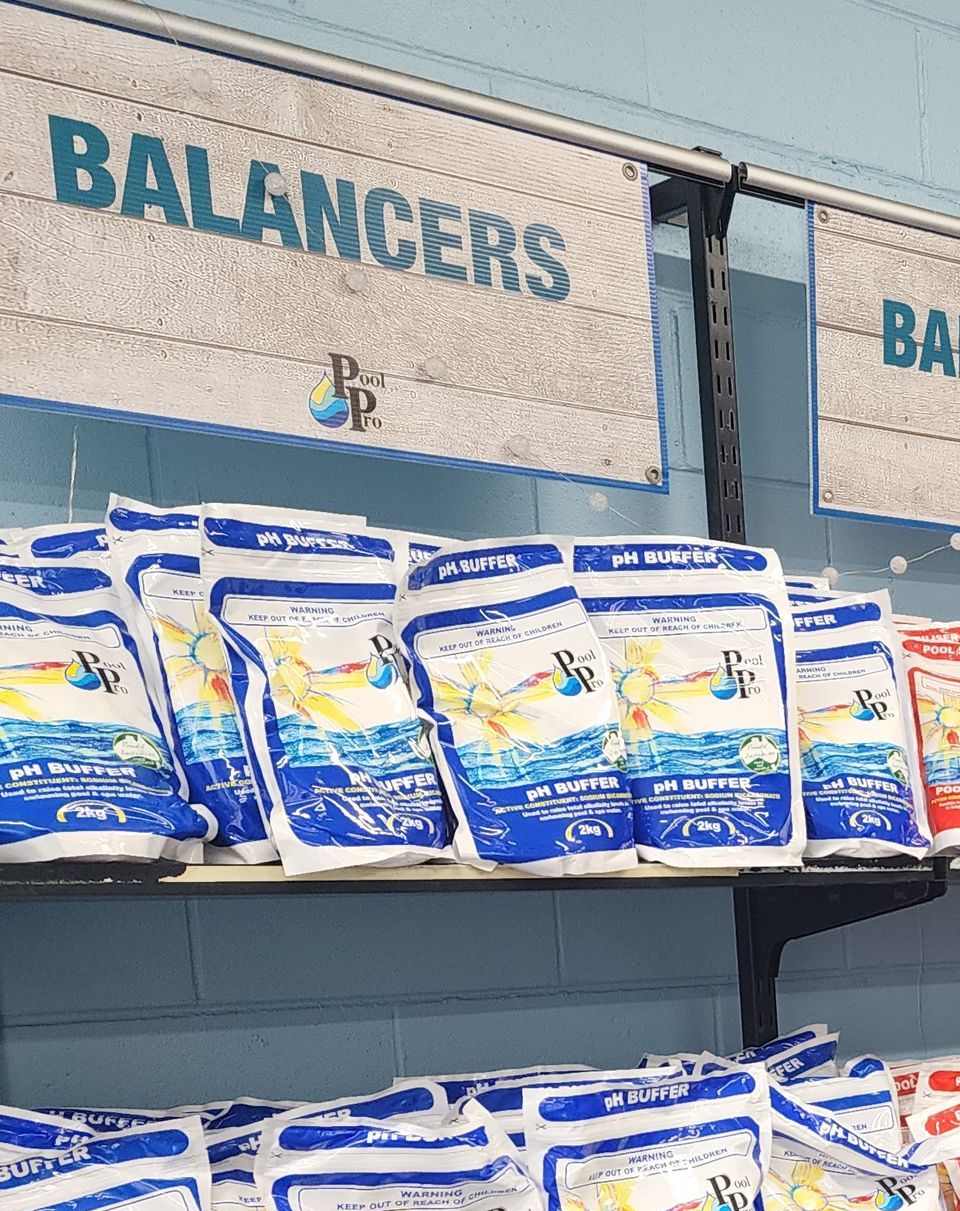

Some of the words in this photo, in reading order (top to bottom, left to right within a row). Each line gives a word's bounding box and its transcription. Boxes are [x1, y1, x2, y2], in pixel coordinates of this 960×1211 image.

[48, 114, 570, 302] BALANCERS
[328, 353, 386, 399] Pool
[348, 386, 383, 432] Pro
[438, 564, 459, 580] pH
[459, 554, 519, 575] BUFFER
[612, 553, 639, 567] pH
[643, 550, 718, 566] BUFFER
[290, 605, 334, 615] WARNING
[651, 616, 696, 624] WARNING
[475, 624, 516, 638] WARNING
[923, 645, 957, 656] POOL
[553, 649, 597, 678] Pool
[721, 650, 764, 679] Pool
[854, 688, 891, 710] Pool
[9, 766, 34, 781] pH
[50, 762, 137, 779] BUFFER
[526, 785, 552, 800] pH
[556, 776, 619, 793] BUFFER
[654, 780, 682, 794] pH
[686, 776, 751, 792] BUFFER
[847, 777, 899, 793] BUFFER
[75, 807, 107, 820] 2kg
[861, 813, 881, 826] 2kg
[579, 824, 601, 837] 2kg
[696, 819, 721, 833] 2kg
[604, 1093, 624, 1112] pH
[626, 1083, 690, 1104] BUFFER
[628, 1150, 674, 1165] WARNING
[400, 1189, 463, 1199] WARNING
[707, 1174, 751, 1207] Pool
[369, 1200, 392, 1210] OUT
